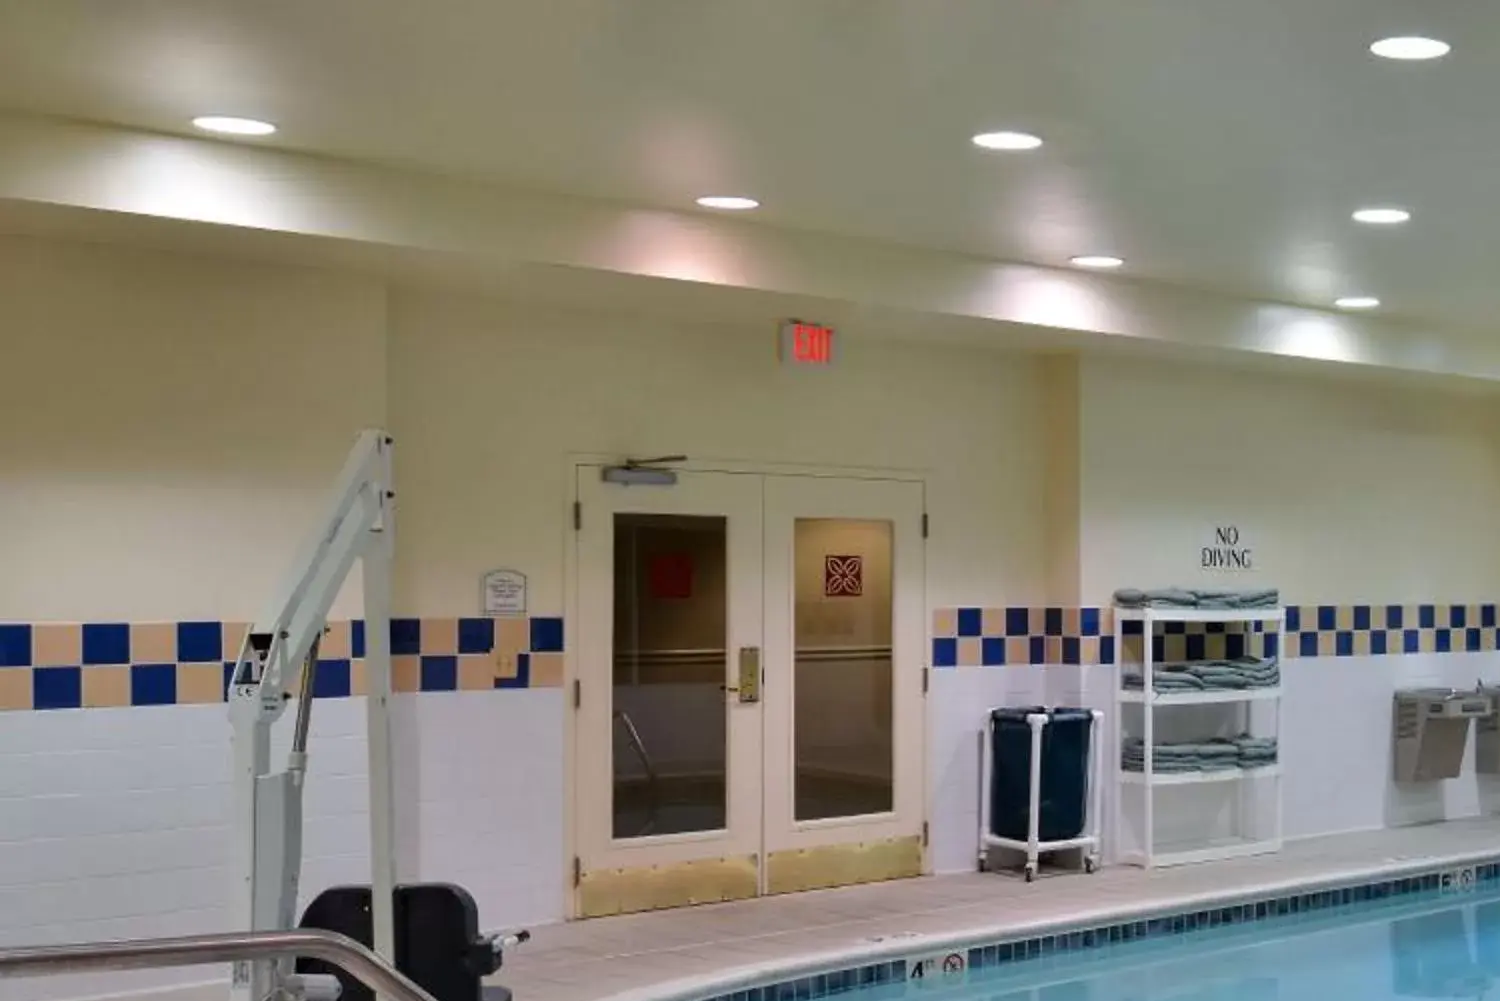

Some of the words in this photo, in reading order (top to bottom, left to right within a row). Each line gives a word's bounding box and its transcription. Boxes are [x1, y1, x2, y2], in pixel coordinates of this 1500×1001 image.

[794, 324, 832, 363] EXIT
[1215, 526, 1239, 545] NO
[1201, 547, 1252, 569] DIVING
